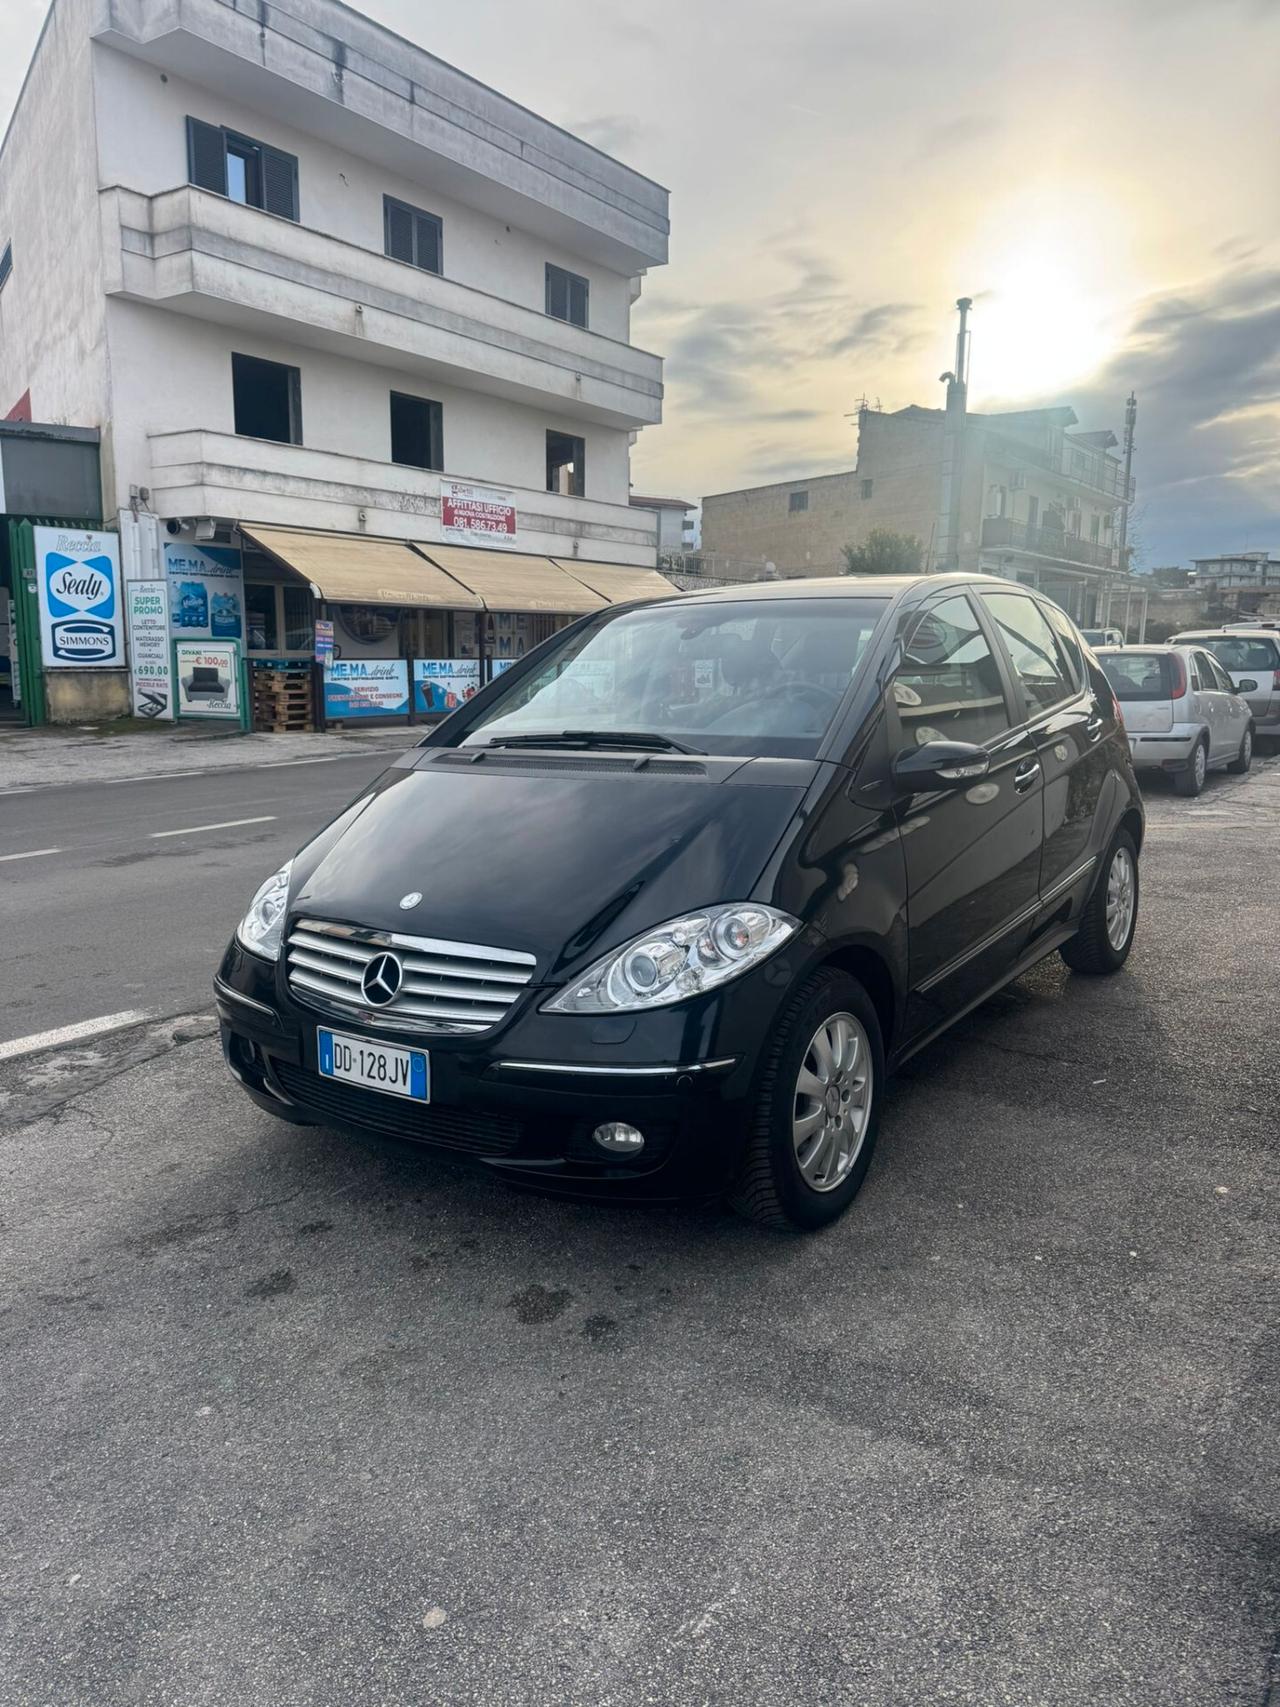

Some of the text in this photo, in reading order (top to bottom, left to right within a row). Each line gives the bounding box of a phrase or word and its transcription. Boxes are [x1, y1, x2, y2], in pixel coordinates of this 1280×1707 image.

[447, 498, 511, 516] AFFITTASI UFFICIO
[56, 571, 102, 600] Sealy
[134, 596, 161, 605] SUPER
[133, 606, 164, 615] PROMO
[59, 635, 110, 646] SIMMONS
